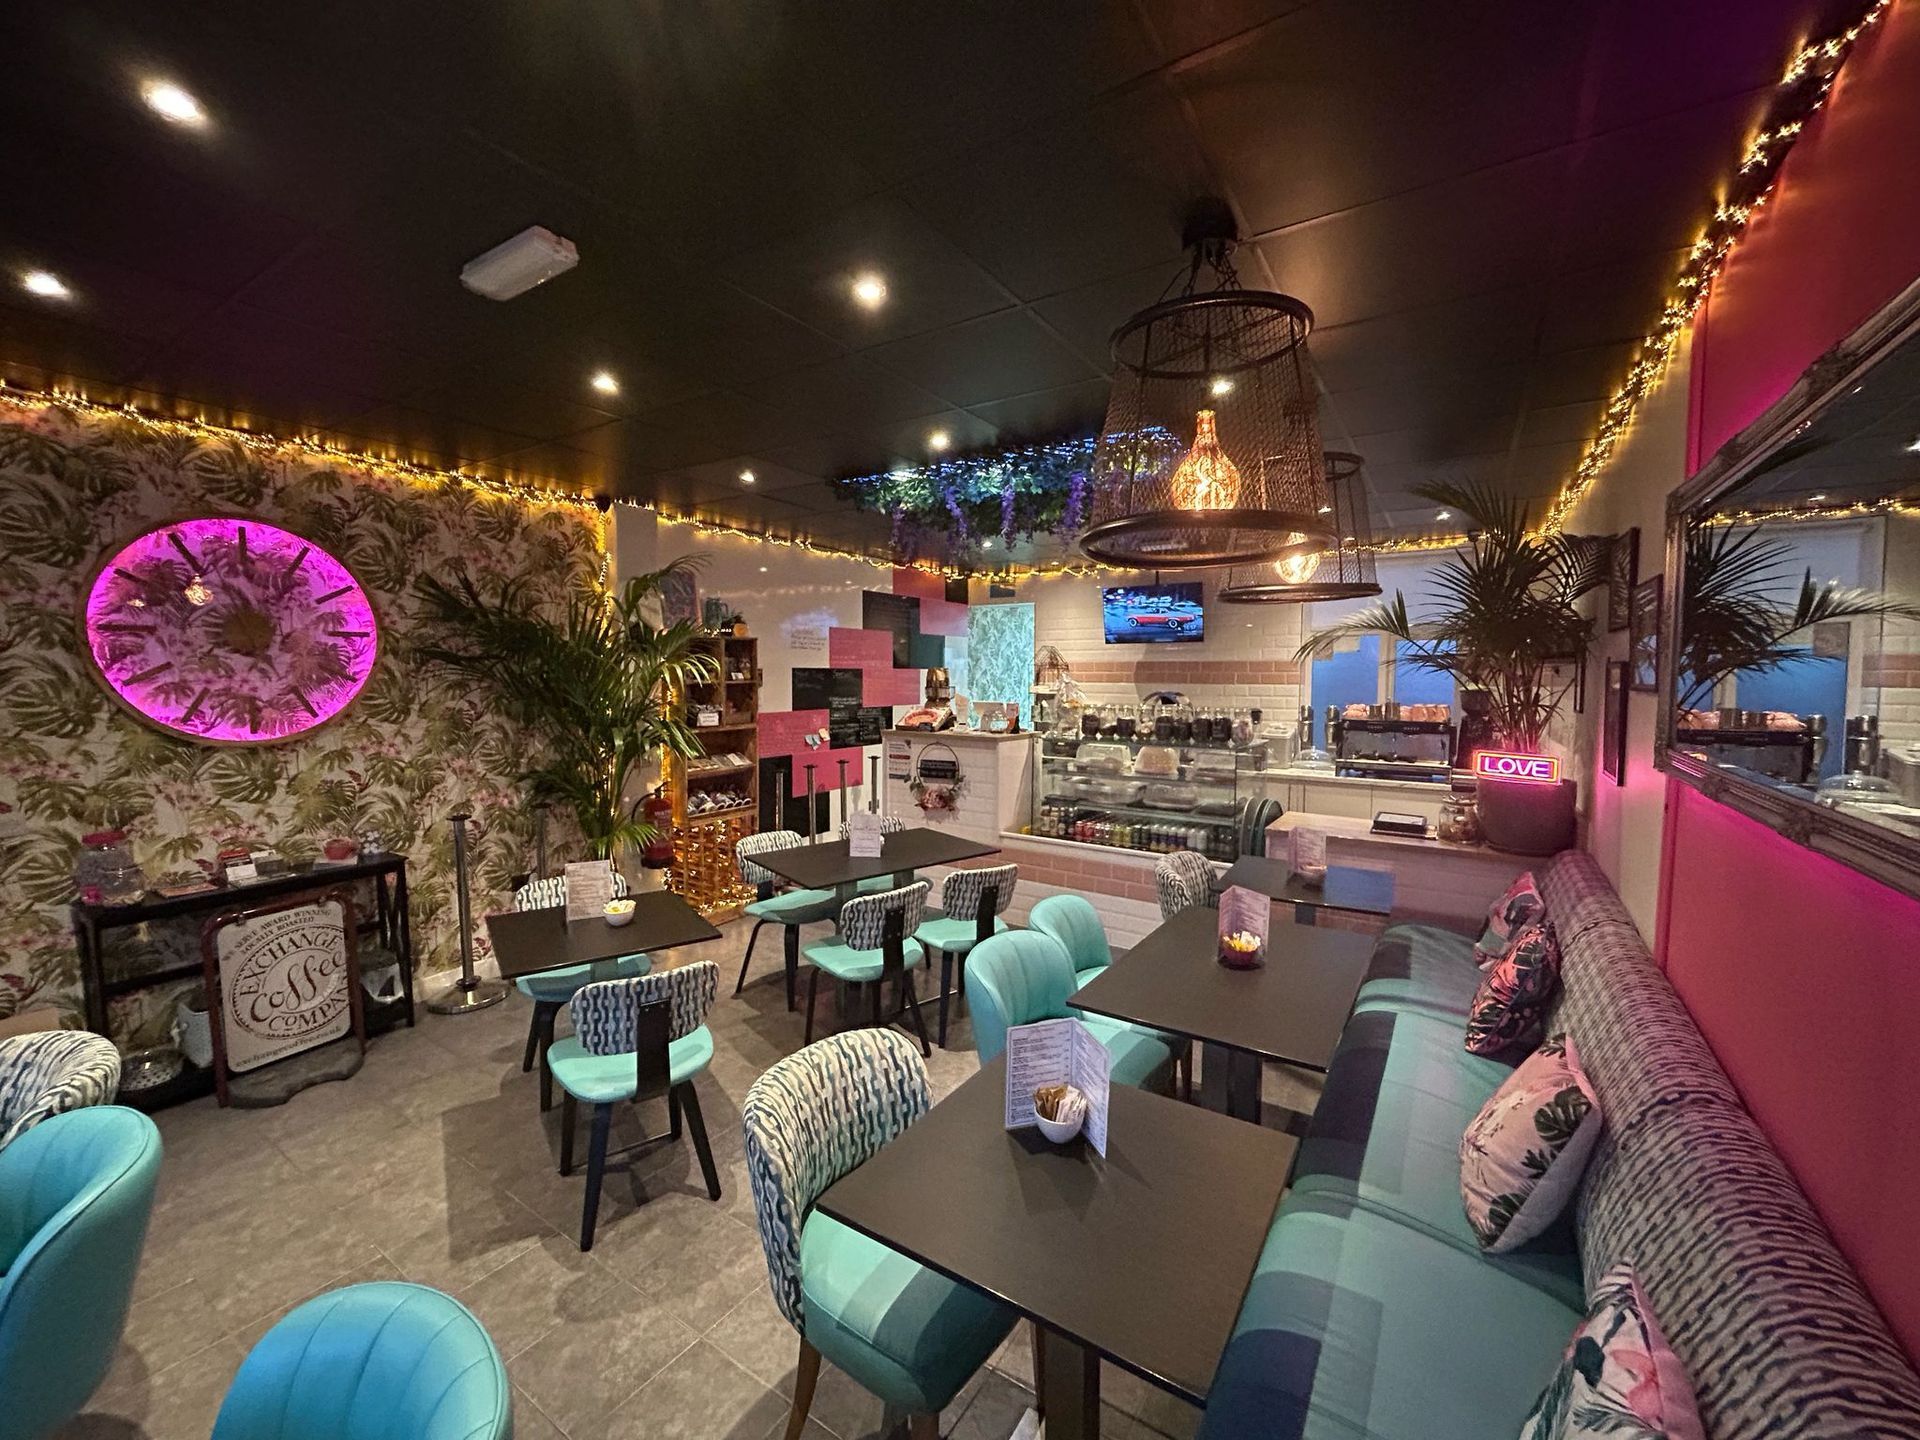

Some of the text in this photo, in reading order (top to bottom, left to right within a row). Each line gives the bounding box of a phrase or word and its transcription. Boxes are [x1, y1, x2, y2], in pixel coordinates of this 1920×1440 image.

[1484, 756, 1550, 778] LOVE
[240, 916, 315, 954] LOCALLY ROASTED
[260, 914, 291, 931] AWARD
[293, 908, 332, 918] WINNING
[239, 931, 344, 996] EXCHANGE
[250, 951, 348, 1023] Coffee
